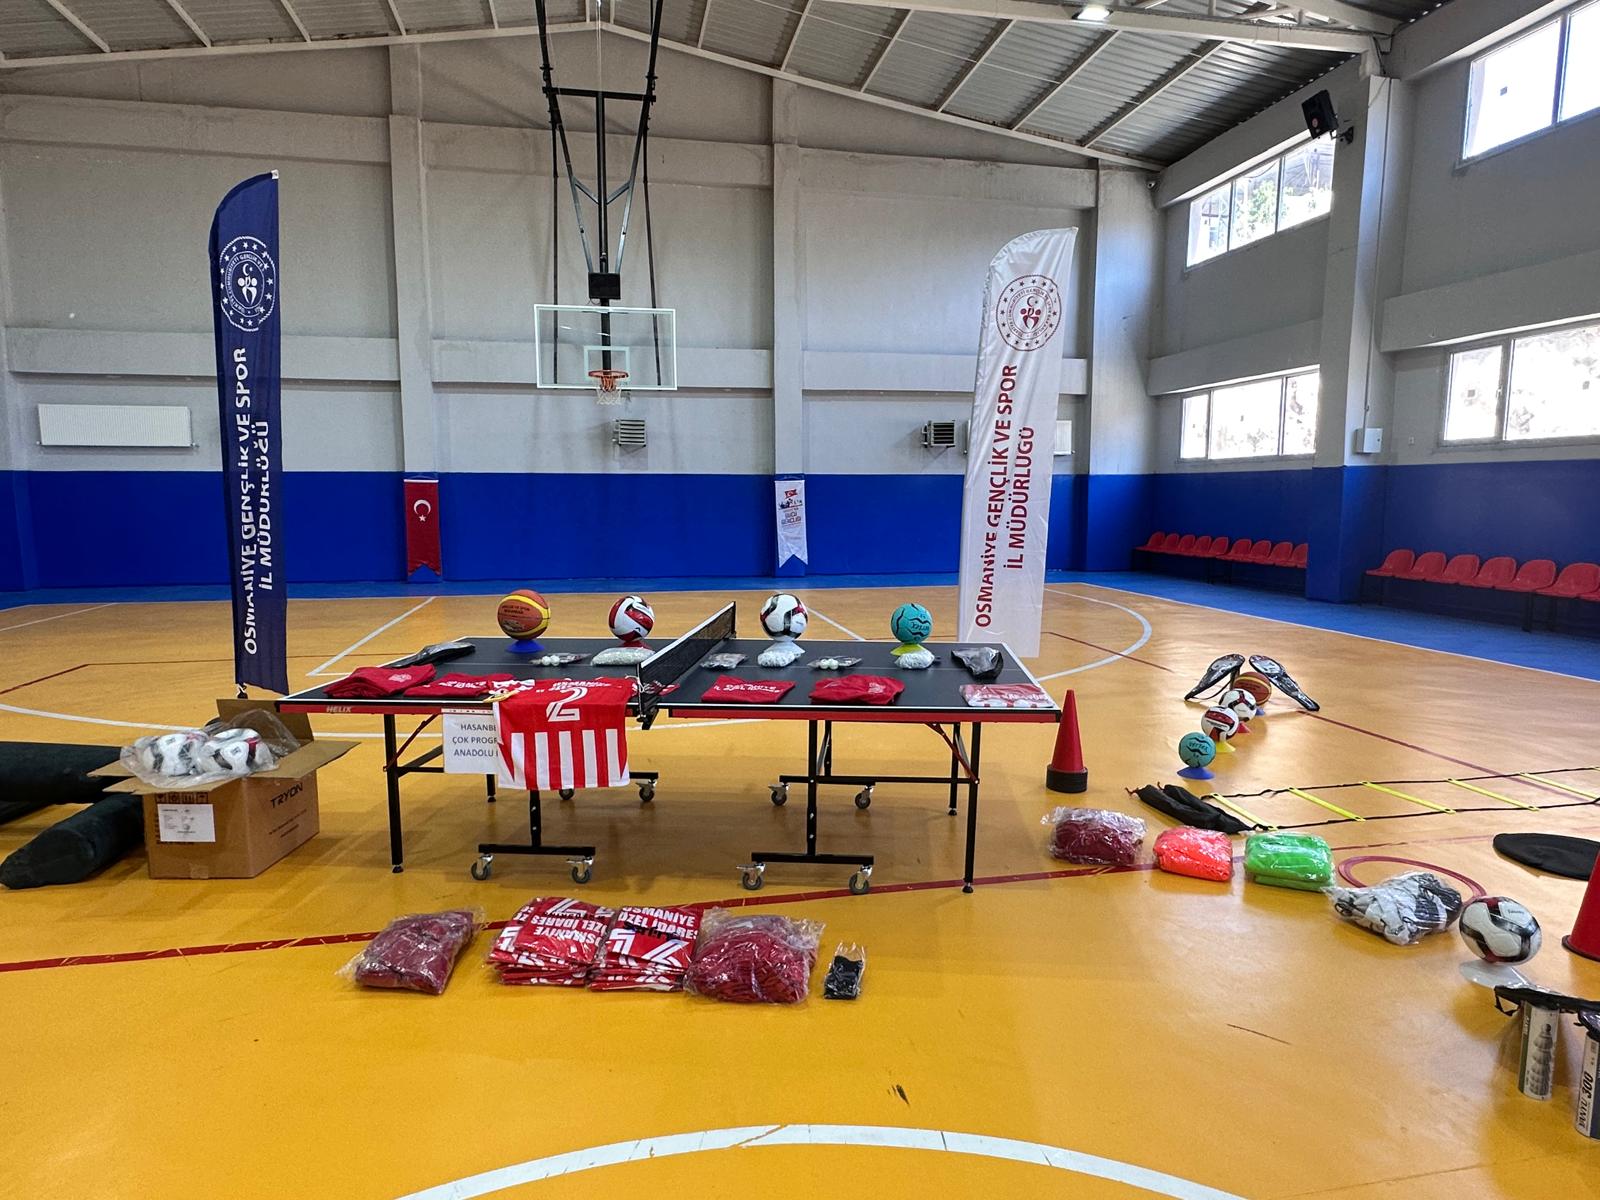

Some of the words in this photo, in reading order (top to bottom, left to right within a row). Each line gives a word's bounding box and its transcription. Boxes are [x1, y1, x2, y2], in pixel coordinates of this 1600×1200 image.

[233, 347, 251, 408] SPOR
[997, 365, 1017, 415] SPOR
[236, 413, 251, 442] VE
[993, 420, 1012, 443] VE
[237, 446, 257, 540] GENÇLİK
[986, 447, 1011, 528] GENÇLİK
[1003, 553, 1023, 569] İL
[258, 572, 273, 590] İL
[975, 532, 997, 628] OSMANİYE
[326, 704, 352, 713] HELIX
[452, 736, 469, 745] ÇOK
[453, 748, 494, 757] ANADOLU
[270, 781, 303, 809] TRYON
[1582, 1070, 1594, 1099] 300
